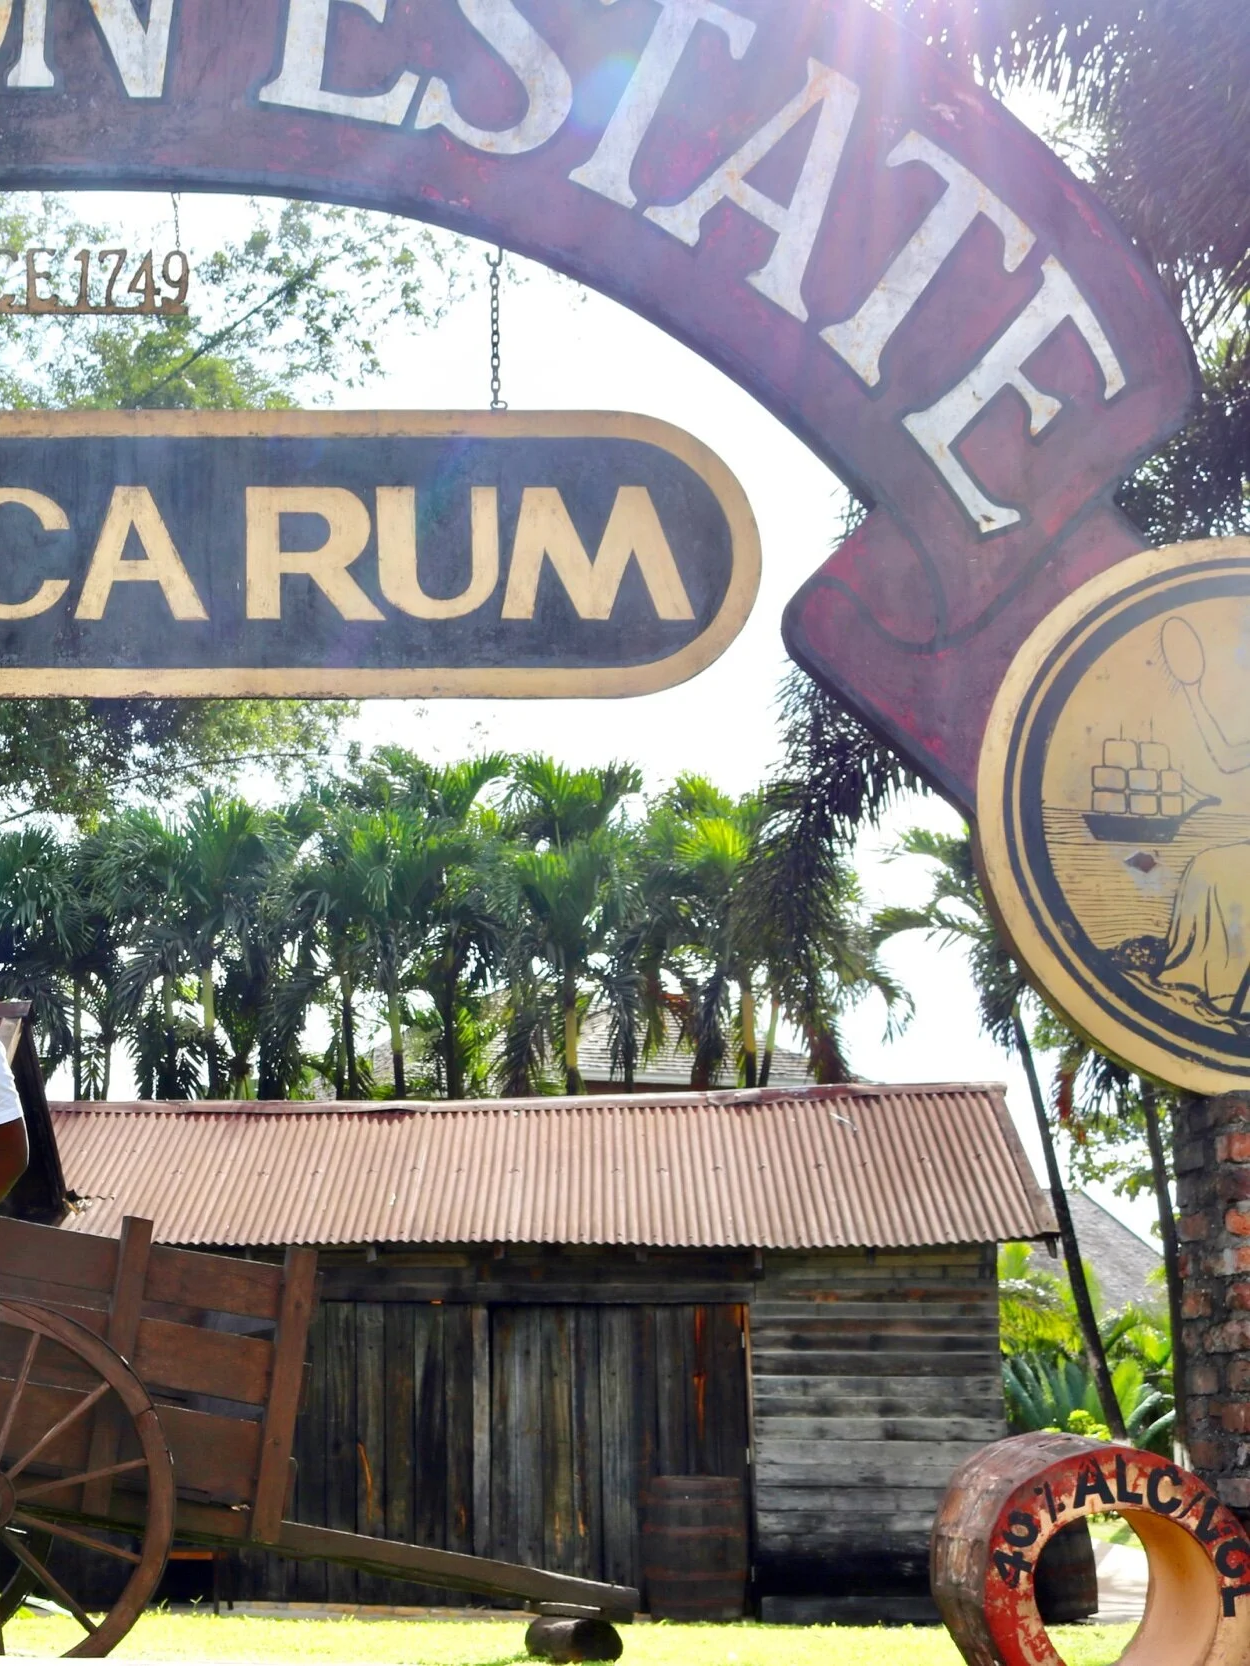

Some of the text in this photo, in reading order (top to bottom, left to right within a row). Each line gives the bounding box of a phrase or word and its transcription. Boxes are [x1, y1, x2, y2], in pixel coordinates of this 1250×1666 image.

[73, 248, 189, 306] 1749
[258, 0, 1127, 534] ESTATE
[245, 485, 698, 623] RUM
